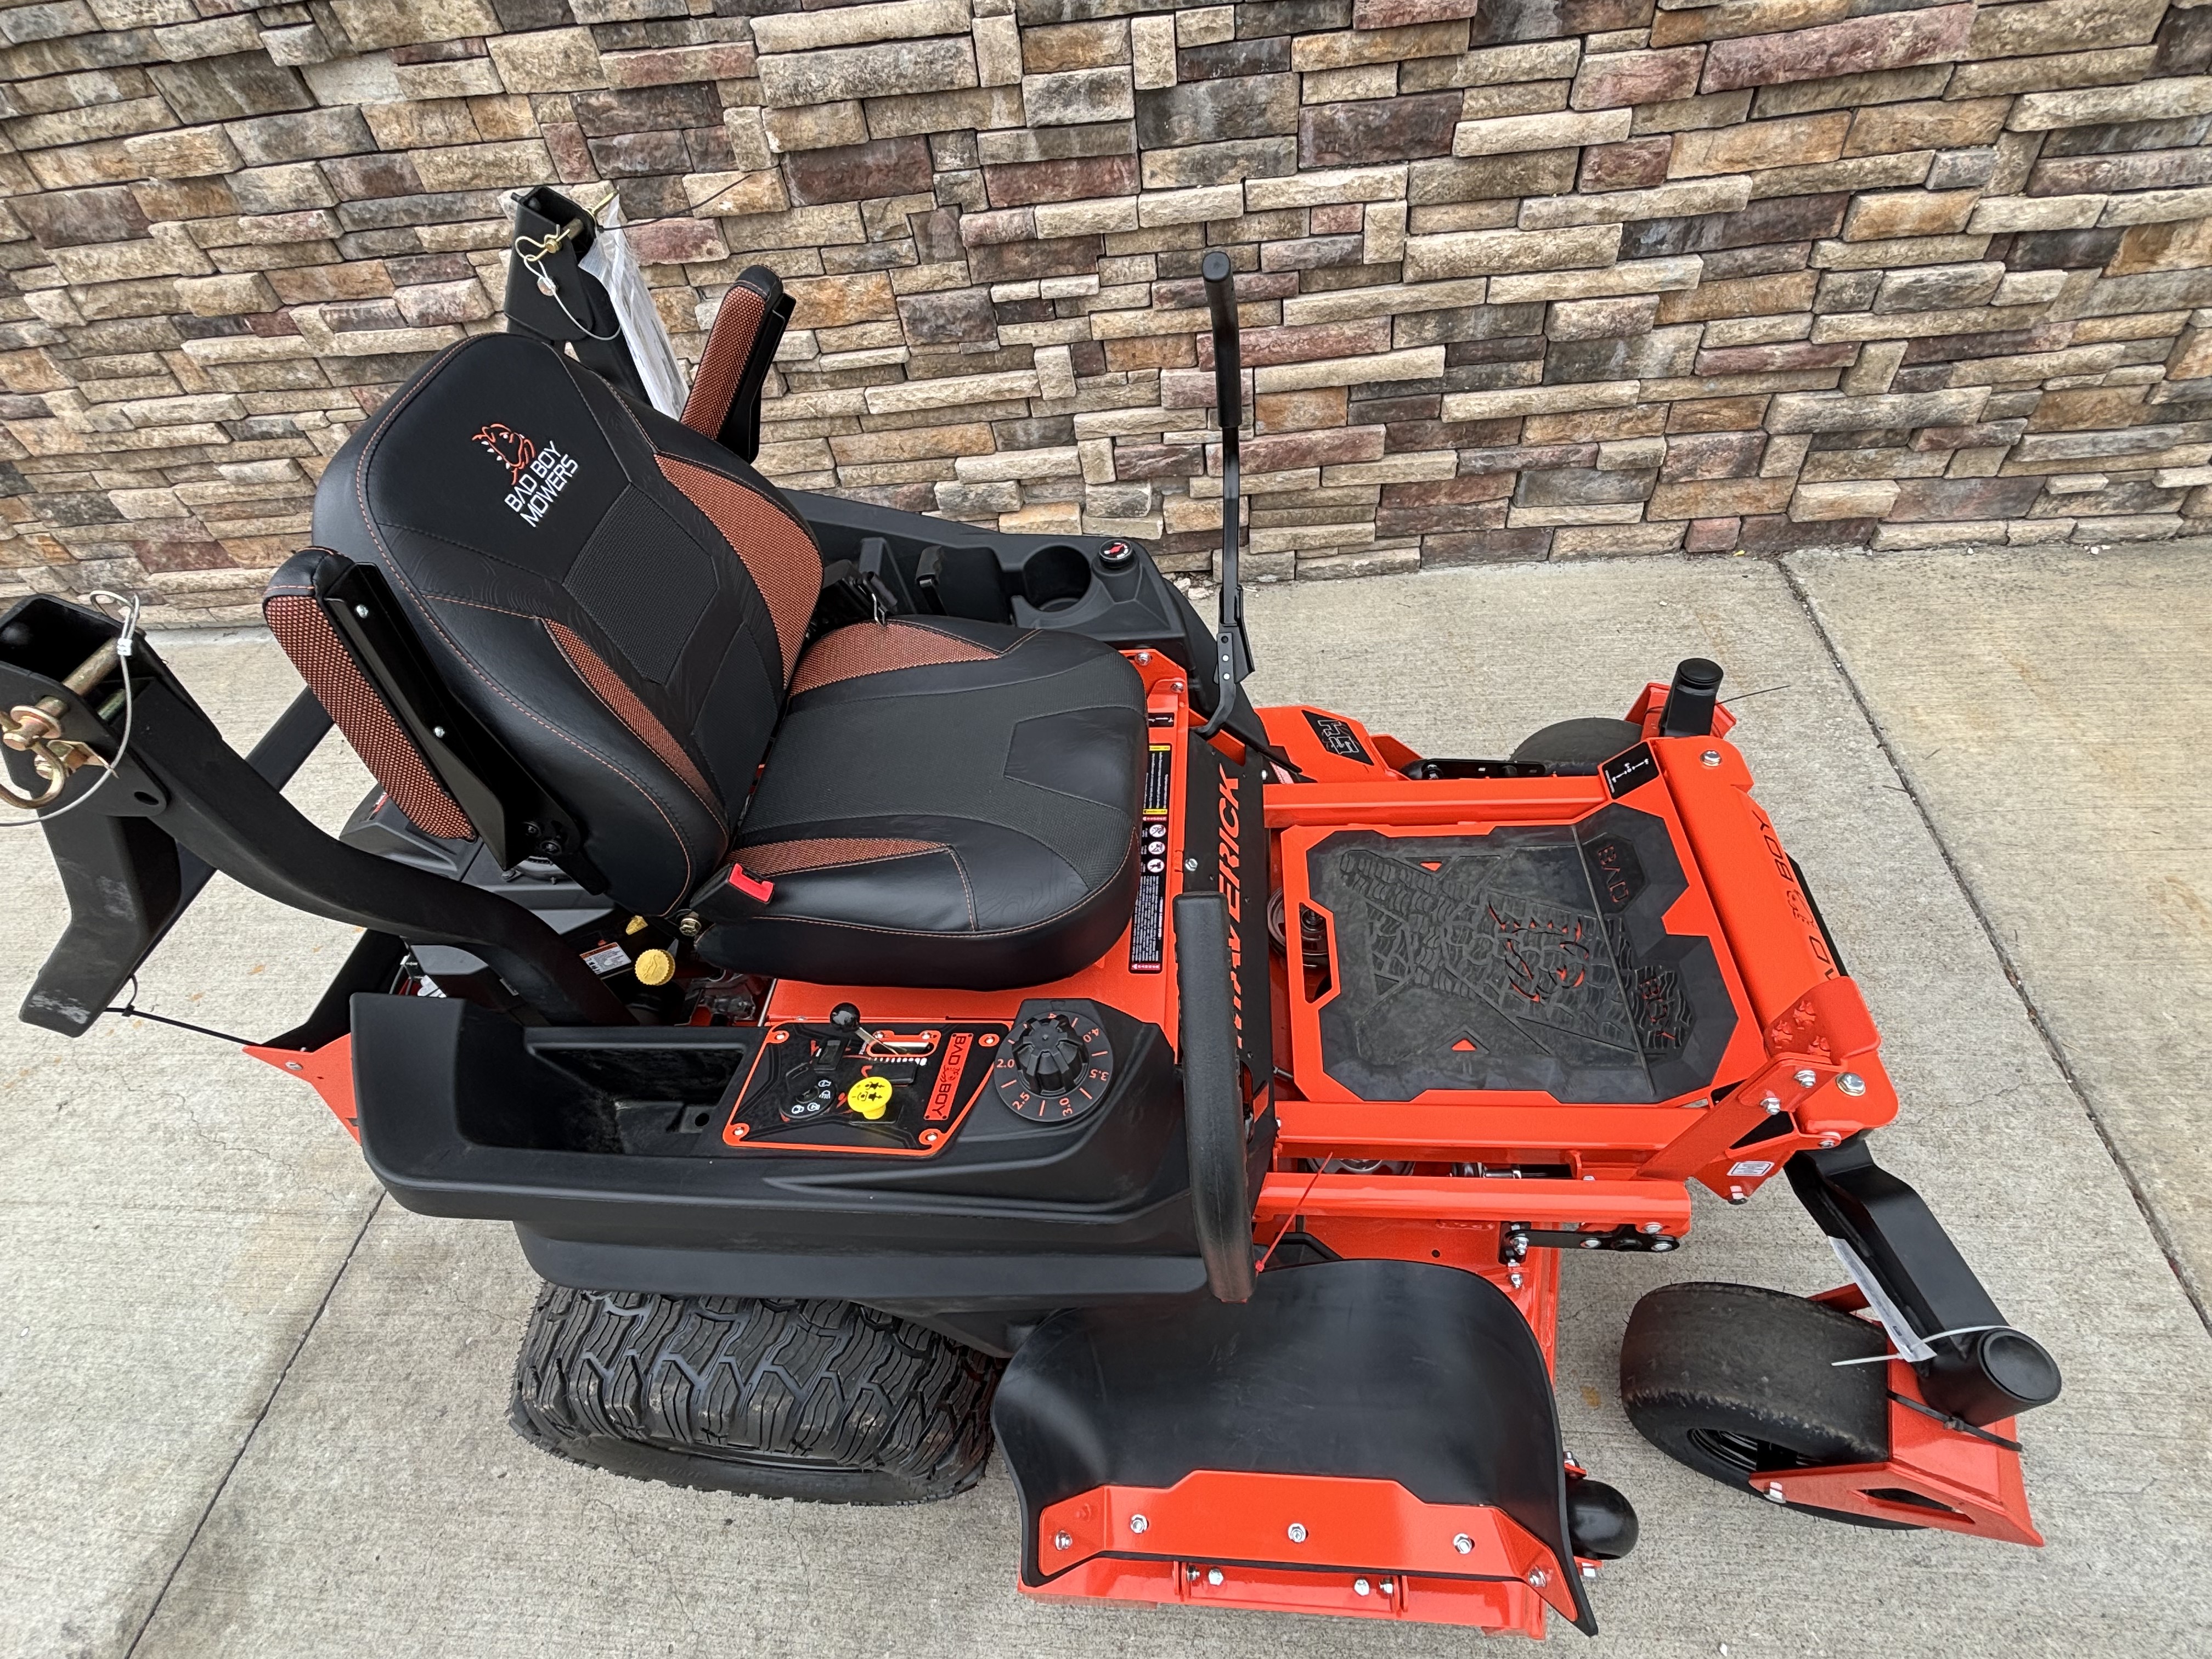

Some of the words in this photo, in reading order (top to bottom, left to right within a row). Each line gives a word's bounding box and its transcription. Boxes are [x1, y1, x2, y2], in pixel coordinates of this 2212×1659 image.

[504, 474, 537, 512] BAD
[530, 440, 561, 479] BOY
[520, 454, 578, 528] MOWERS
[1751, 809, 1794, 882] BOY
[1598, 845, 1629, 902] BAD
[1082, 1028, 1100, 1043] 4.0
[948, 1036, 967, 1065] BAD
[996, 1059, 1015, 1069] 2.0
[1088, 1069, 1109, 1082] 3.5
[932, 1083, 952, 1116] BOY
[1012, 1091, 1031, 1111] 2.5
[1058, 1097, 1073, 1116] 3.0
